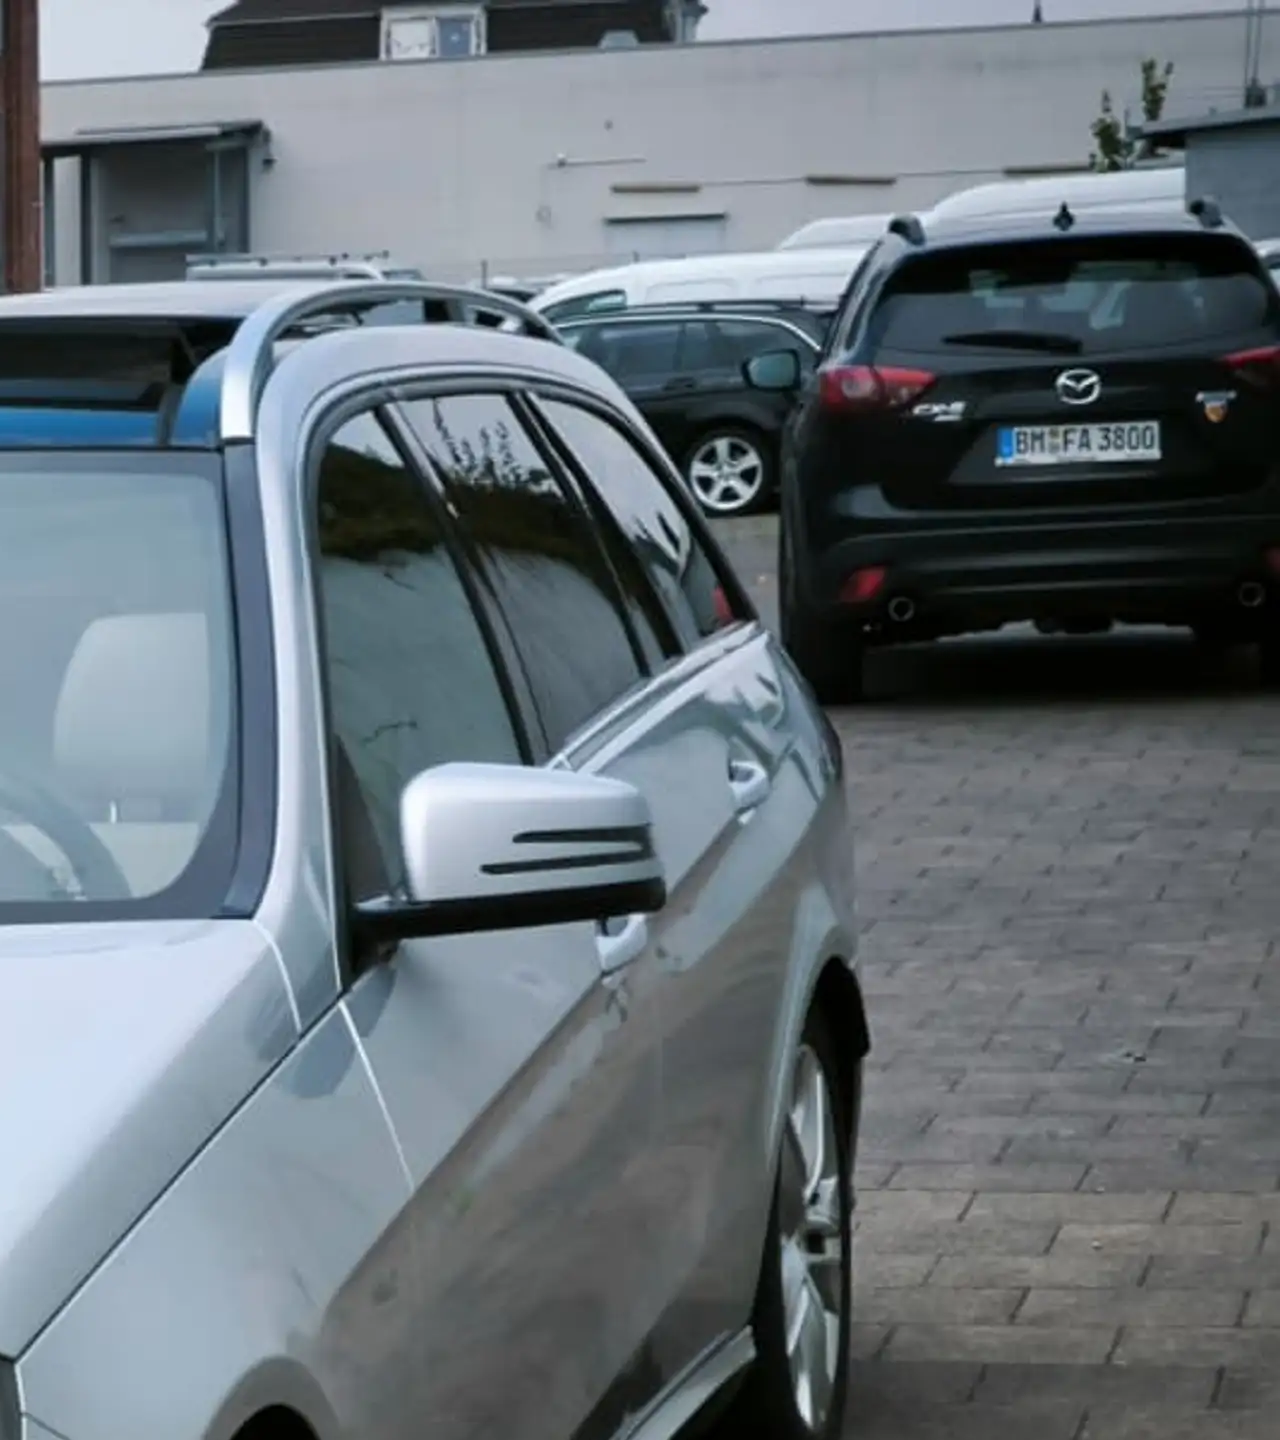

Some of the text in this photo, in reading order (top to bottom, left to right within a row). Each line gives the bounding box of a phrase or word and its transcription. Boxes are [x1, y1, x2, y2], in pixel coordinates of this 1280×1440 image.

[1015, 425, 1156, 454] BM FA 3800
